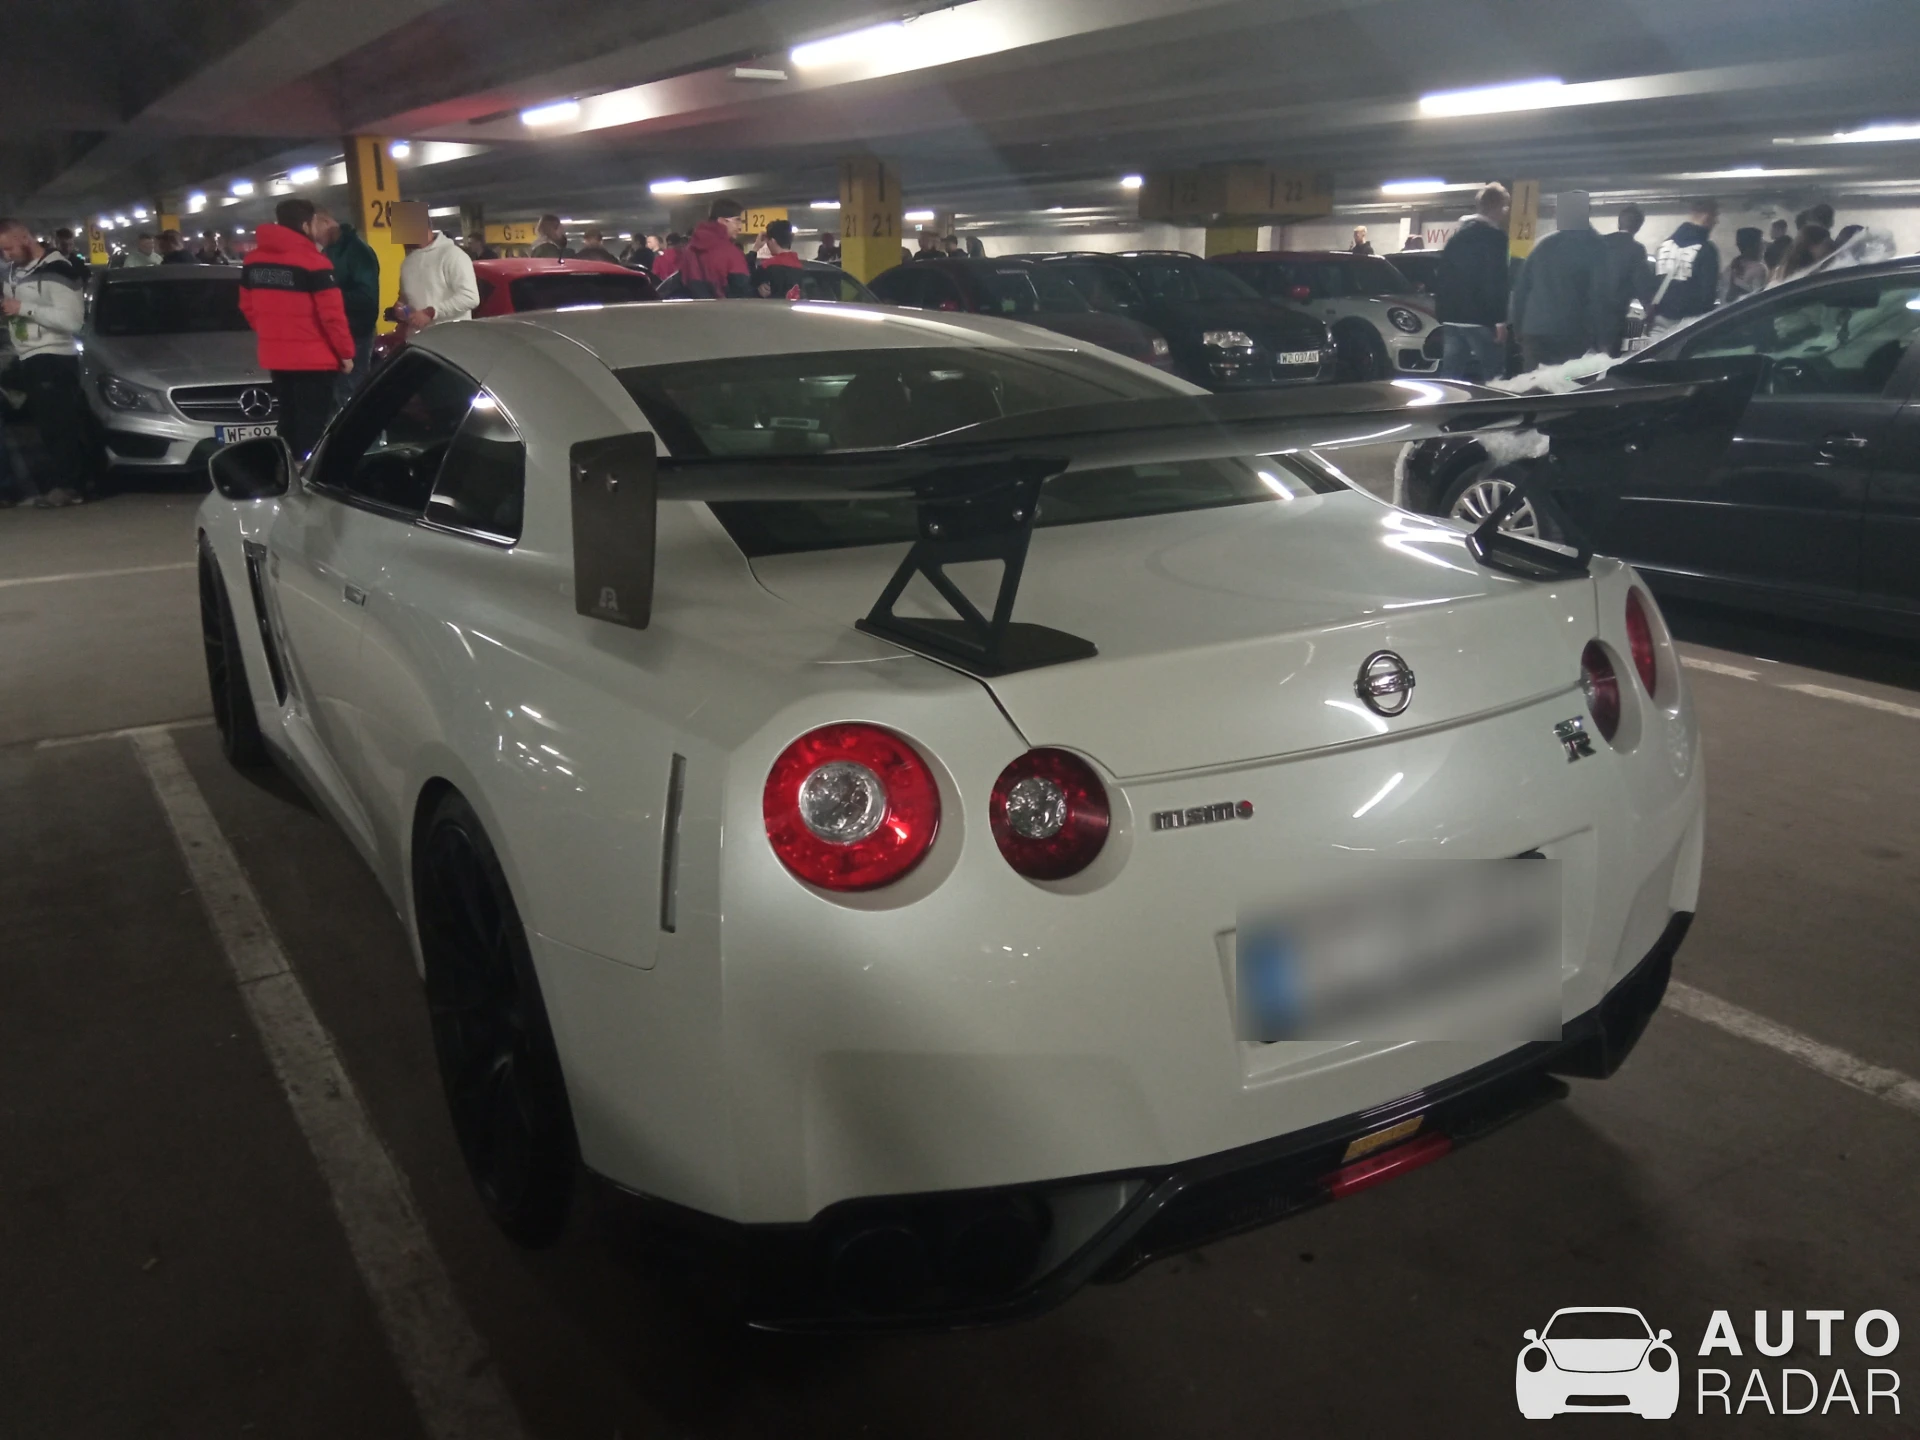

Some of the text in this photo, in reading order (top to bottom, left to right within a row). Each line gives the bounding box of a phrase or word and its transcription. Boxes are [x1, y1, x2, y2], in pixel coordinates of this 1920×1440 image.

[753, 214, 765, 228] 22
[845, 214, 857, 237] 21
[872, 213, 892, 237] 21
[503, 225, 511, 241] G
